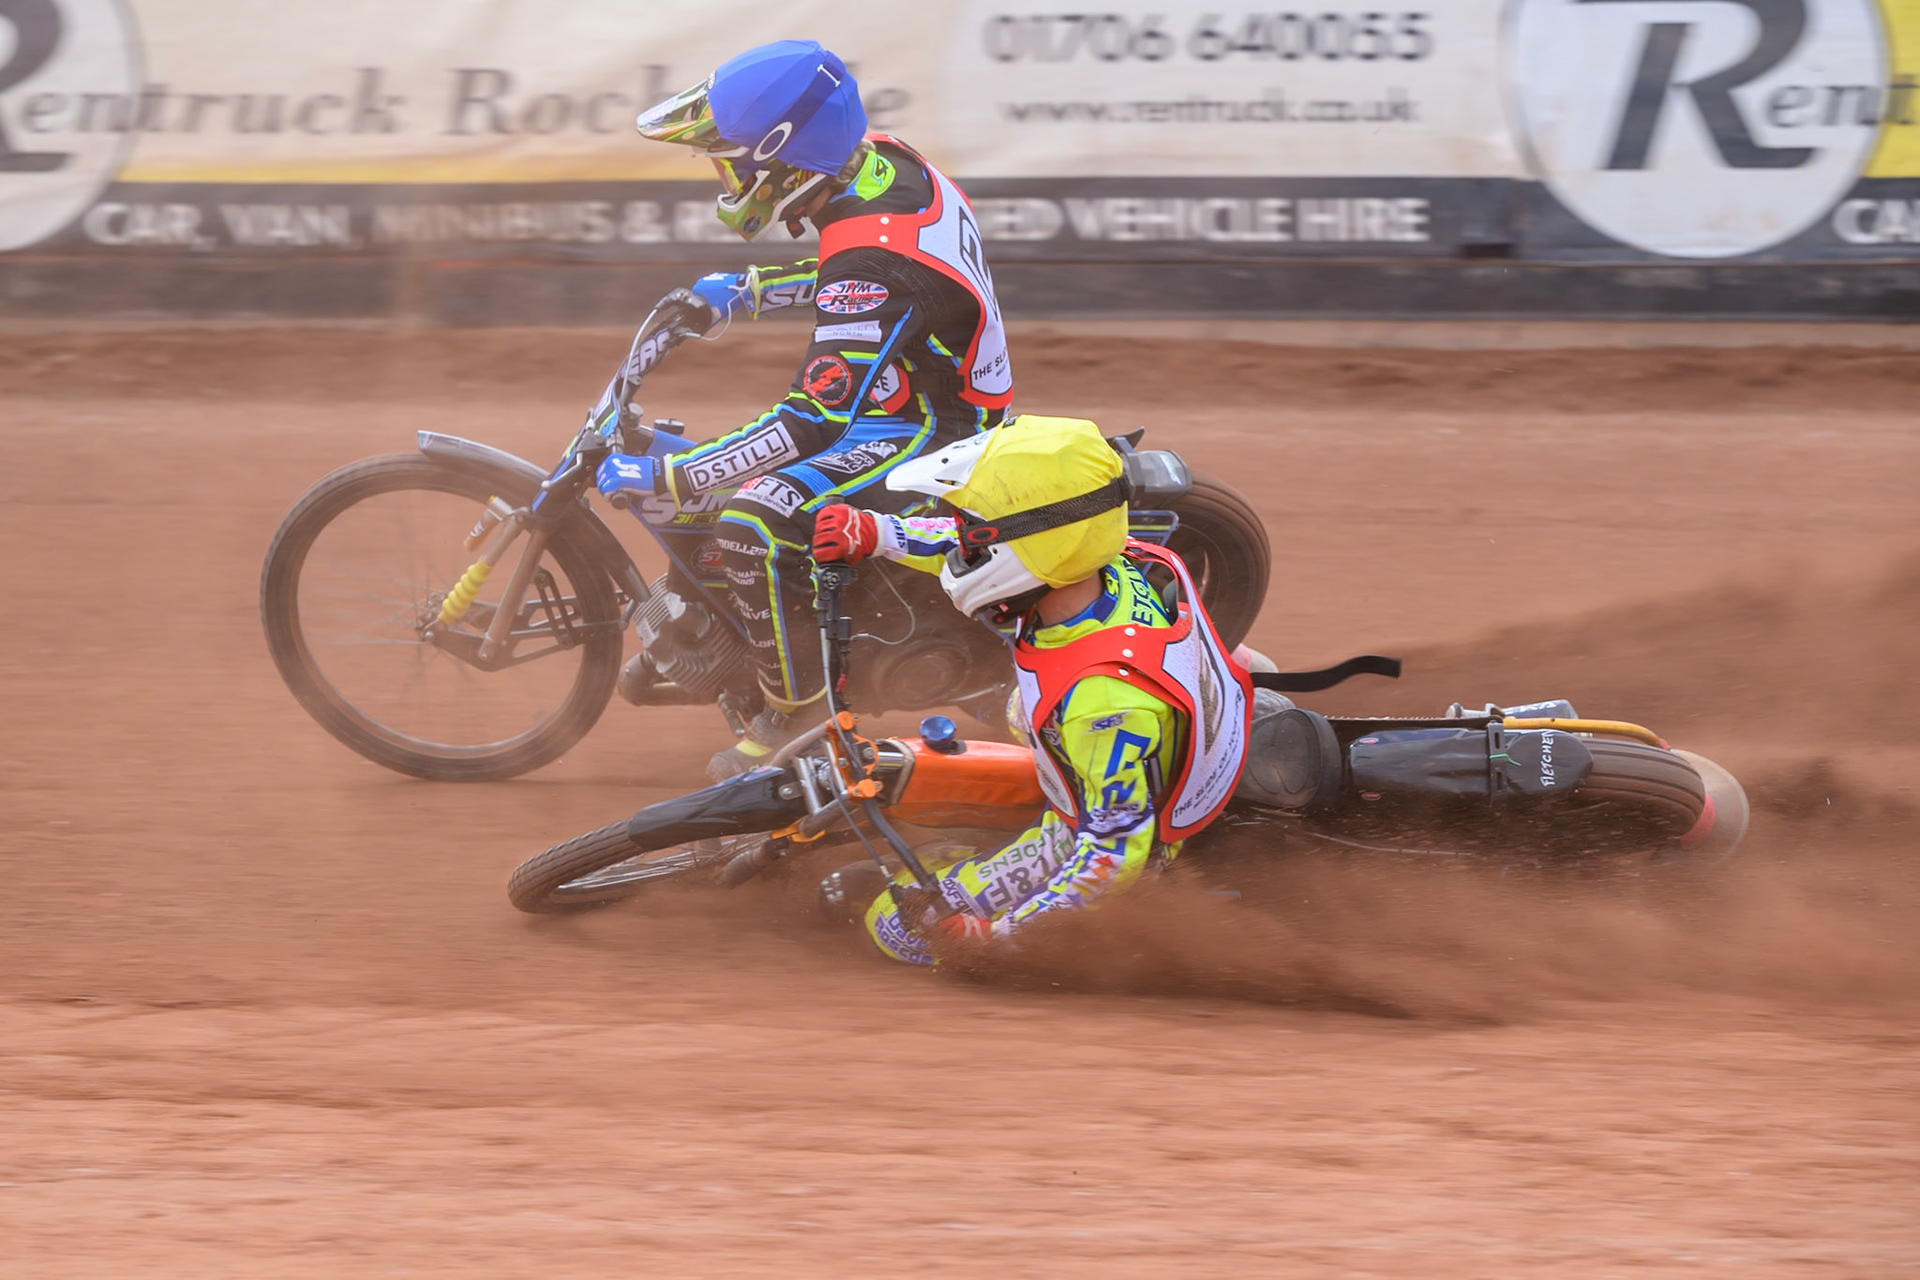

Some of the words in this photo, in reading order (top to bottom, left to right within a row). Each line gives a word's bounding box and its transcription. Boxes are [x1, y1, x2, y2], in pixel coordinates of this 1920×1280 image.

[983, 11, 1174, 63] 01706
[1186, 12, 1434, 62] 640055
[1064, 198, 1293, 242] VEHICLE
[1296, 198, 1431, 242] HIRE
[973, 362, 992, 380] THE
[694, 438, 782, 487] DSTILL
[753, 477, 801, 507] FTS
